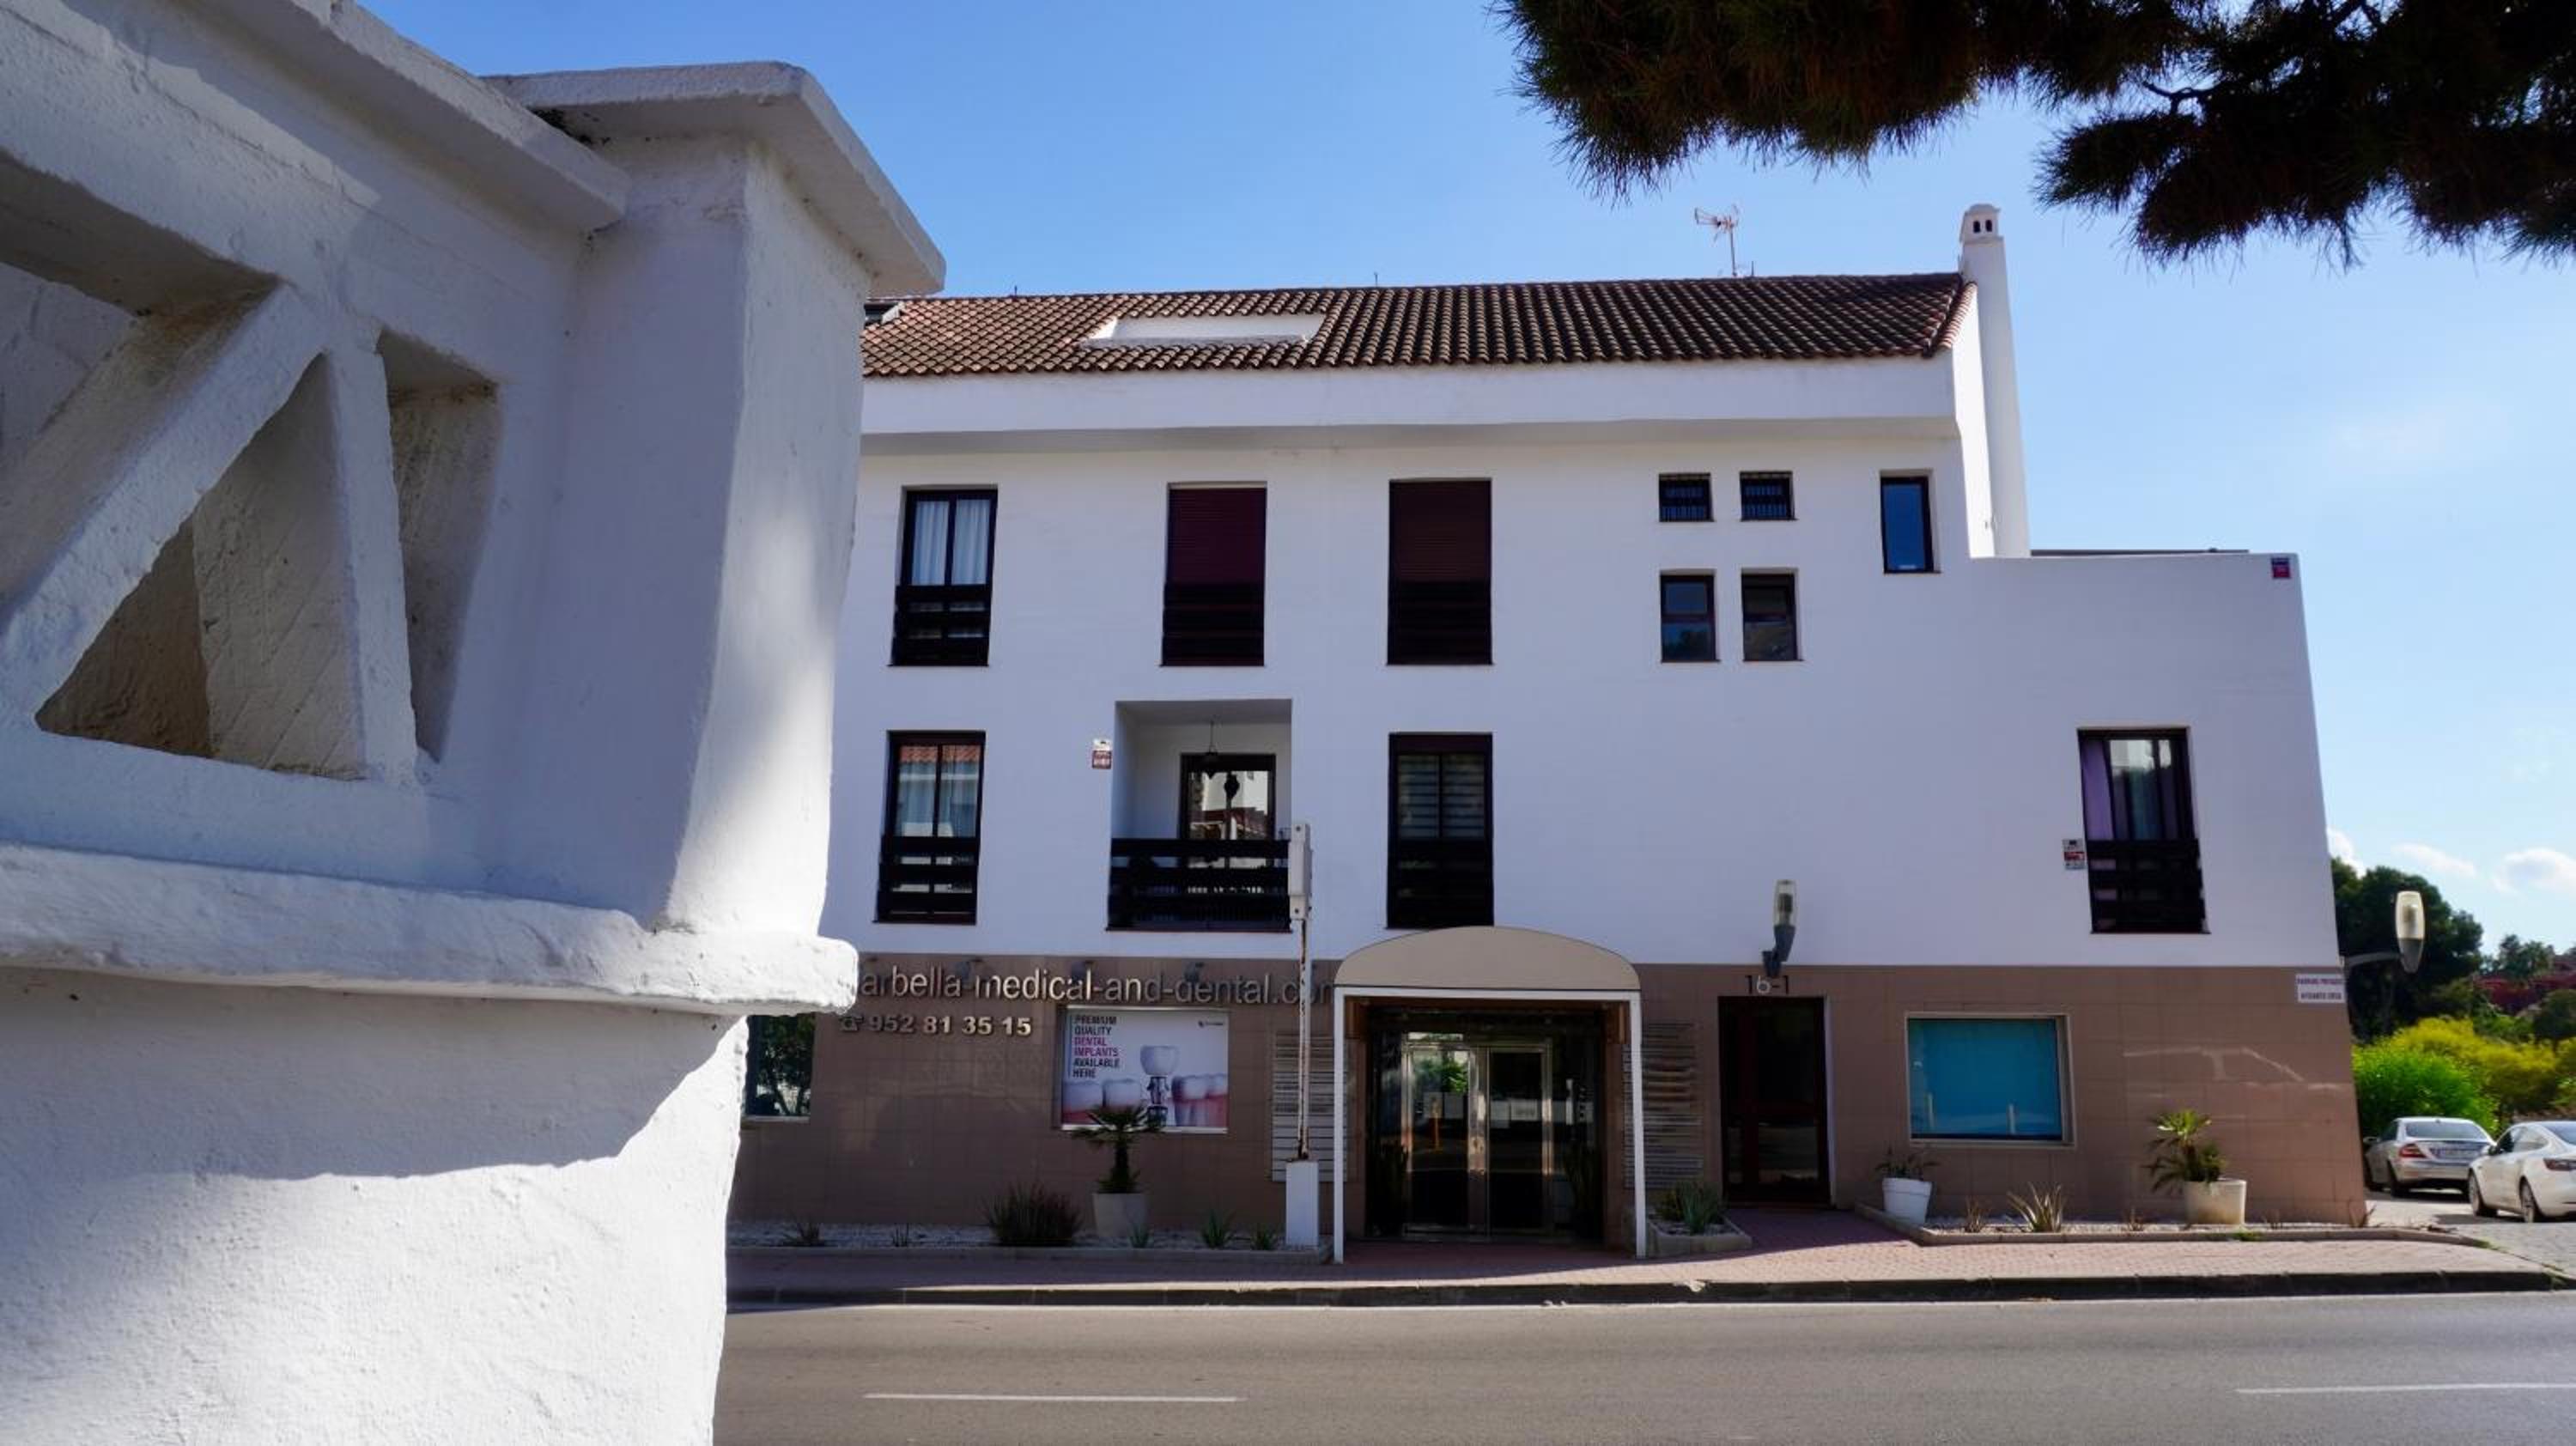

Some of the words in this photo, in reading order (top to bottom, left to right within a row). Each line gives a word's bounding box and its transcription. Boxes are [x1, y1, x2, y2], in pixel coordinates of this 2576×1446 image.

[860, 964, 1334, 1005] arbella-medical-and-dental.c
[1074, 1016, 1116, 1024] PREMIUM
[869, 1016, 914, 1032] 952
[923, 1016, 952, 1034] 81
[962, 1016, 993, 1036] 35
[1002, 1017, 1032, 1036] 15
[1074, 1025, 1112, 1036] QUALITY
[1074, 1036, 1107, 1046] DENTAL
[1074, 1047, 1119, 1057] IMPLANTS
[1073, 1057, 1120, 1067] AVAILABLE
[1072, 1068, 1096, 1078] HERE
